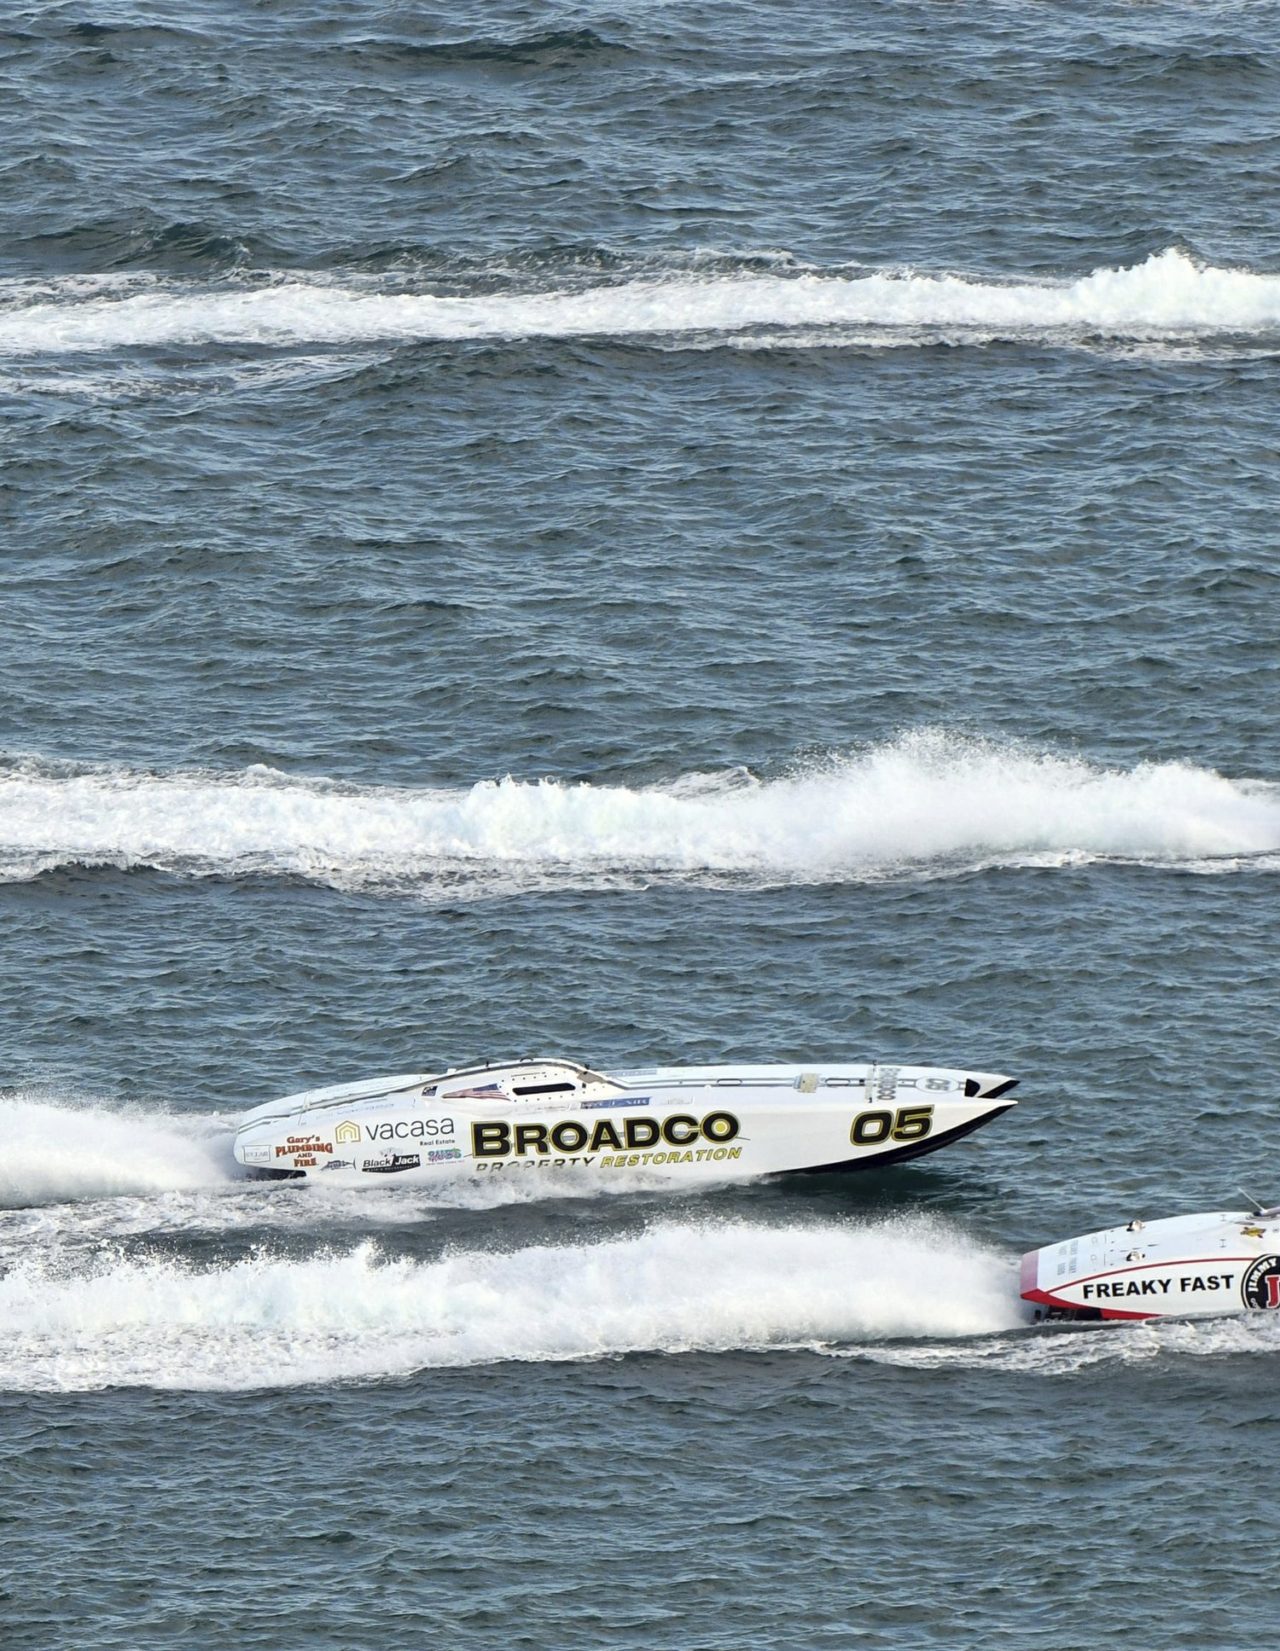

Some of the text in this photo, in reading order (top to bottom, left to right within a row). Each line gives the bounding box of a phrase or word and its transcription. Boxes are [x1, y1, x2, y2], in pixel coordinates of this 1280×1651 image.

[365, 1117, 455, 1141] vacasa
[471, 1109, 741, 1159] BROADCO
[849, 1104, 935, 1147] 05
[275, 1142, 334, 1158] PLUMBING
[286, 1134, 321, 1144] Gary's
[293, 1158, 317, 1167] FIRE
[363, 1158, 391, 1168] Black
[394, 1155, 419, 1165] Jack
[600, 1147, 742, 1169] RESTORATION
[1247, 1257, 1278, 1293] JIMMY
[1082, 1274, 1235, 1300] FREAKY FAST
